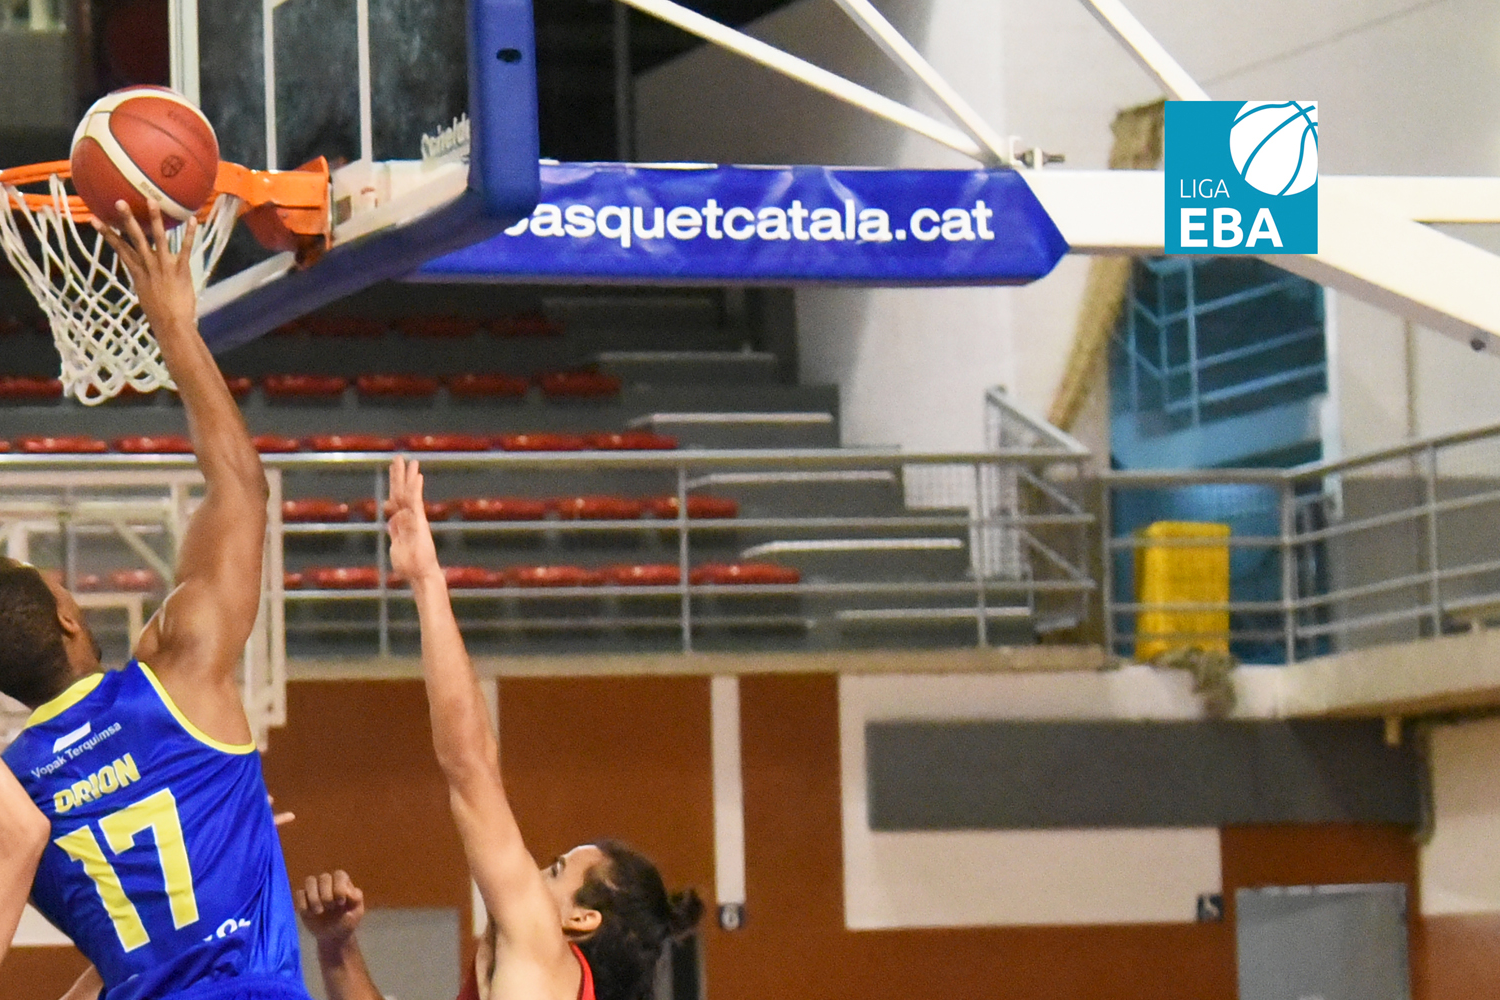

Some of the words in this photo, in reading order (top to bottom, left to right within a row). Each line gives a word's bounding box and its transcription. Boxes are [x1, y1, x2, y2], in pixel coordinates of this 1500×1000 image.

[31, 755, 67, 779] Vopak
[64, 721, 122, 760] Terquimsa
[52, 786, 200, 954] 17
